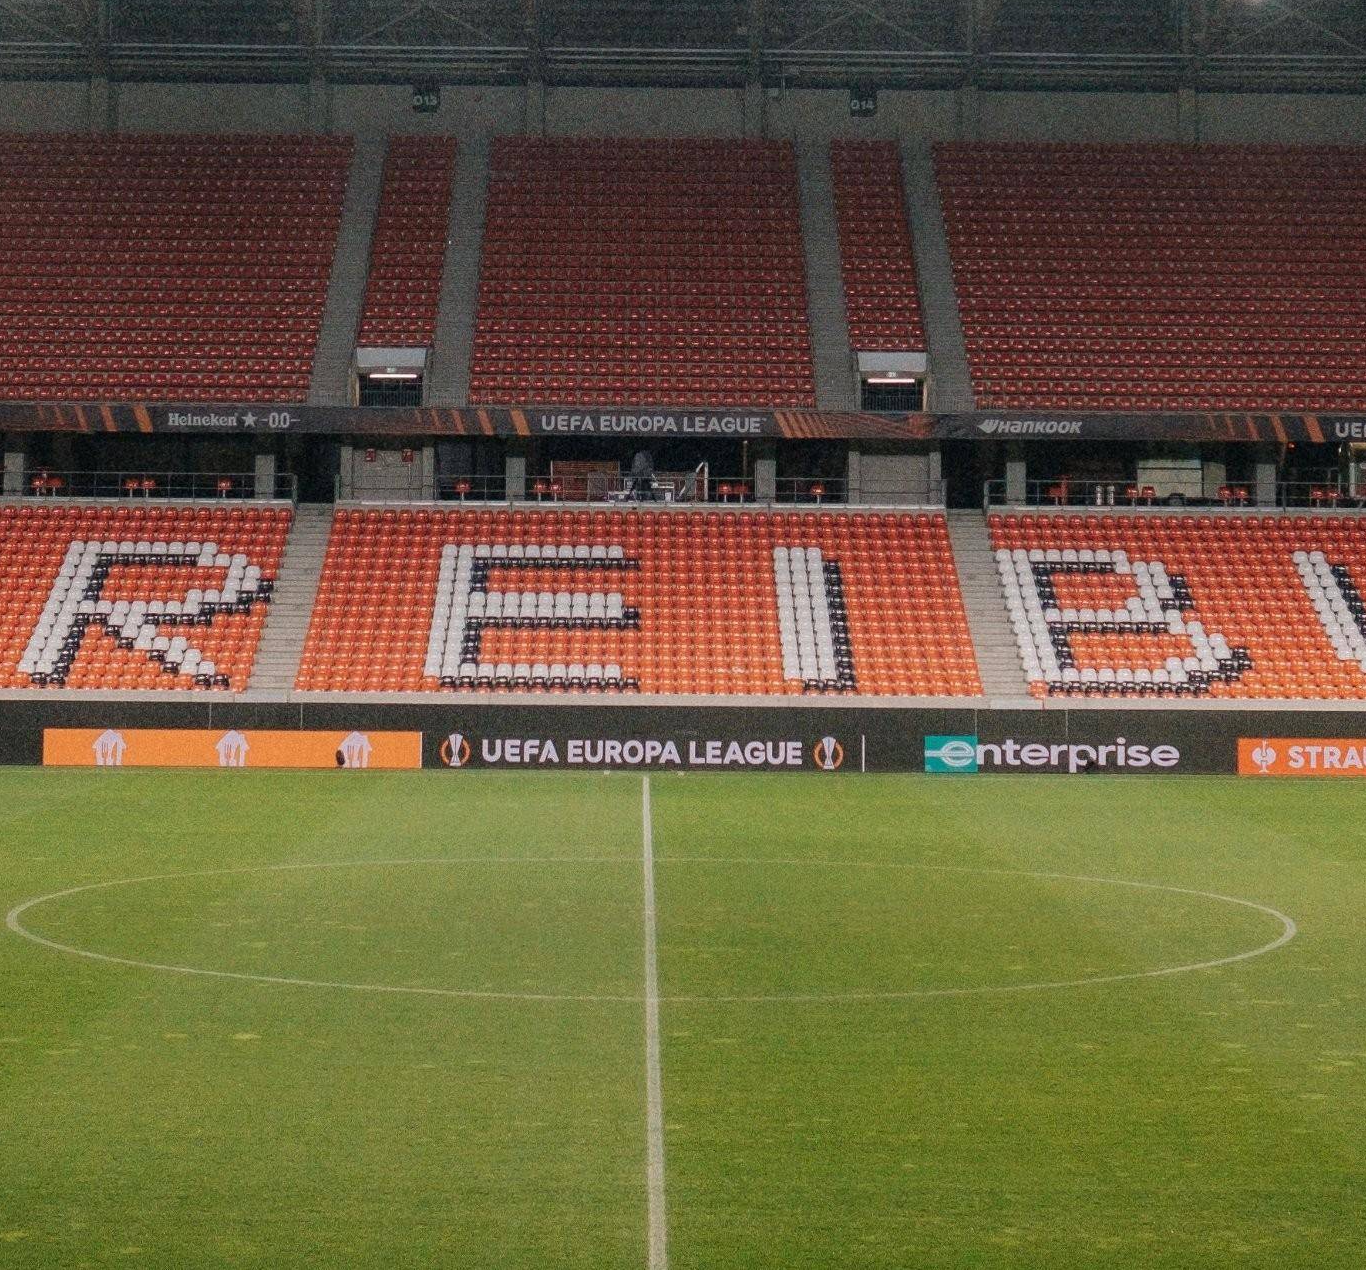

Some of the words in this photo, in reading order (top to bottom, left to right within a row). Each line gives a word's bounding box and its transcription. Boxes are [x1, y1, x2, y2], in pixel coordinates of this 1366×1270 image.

[168, 412, 237, 427] Heineken
[541, 414, 593, 431] UEFA
[599, 416, 677, 432] EUROPA
[683, 417, 761, 433] LEAGUE
[481, 739, 559, 764] UEFA
[567, 740, 681, 765] EUROPA
[689, 741, 803, 766] LEAGUE
[934, 738, 1180, 773] enterprise
